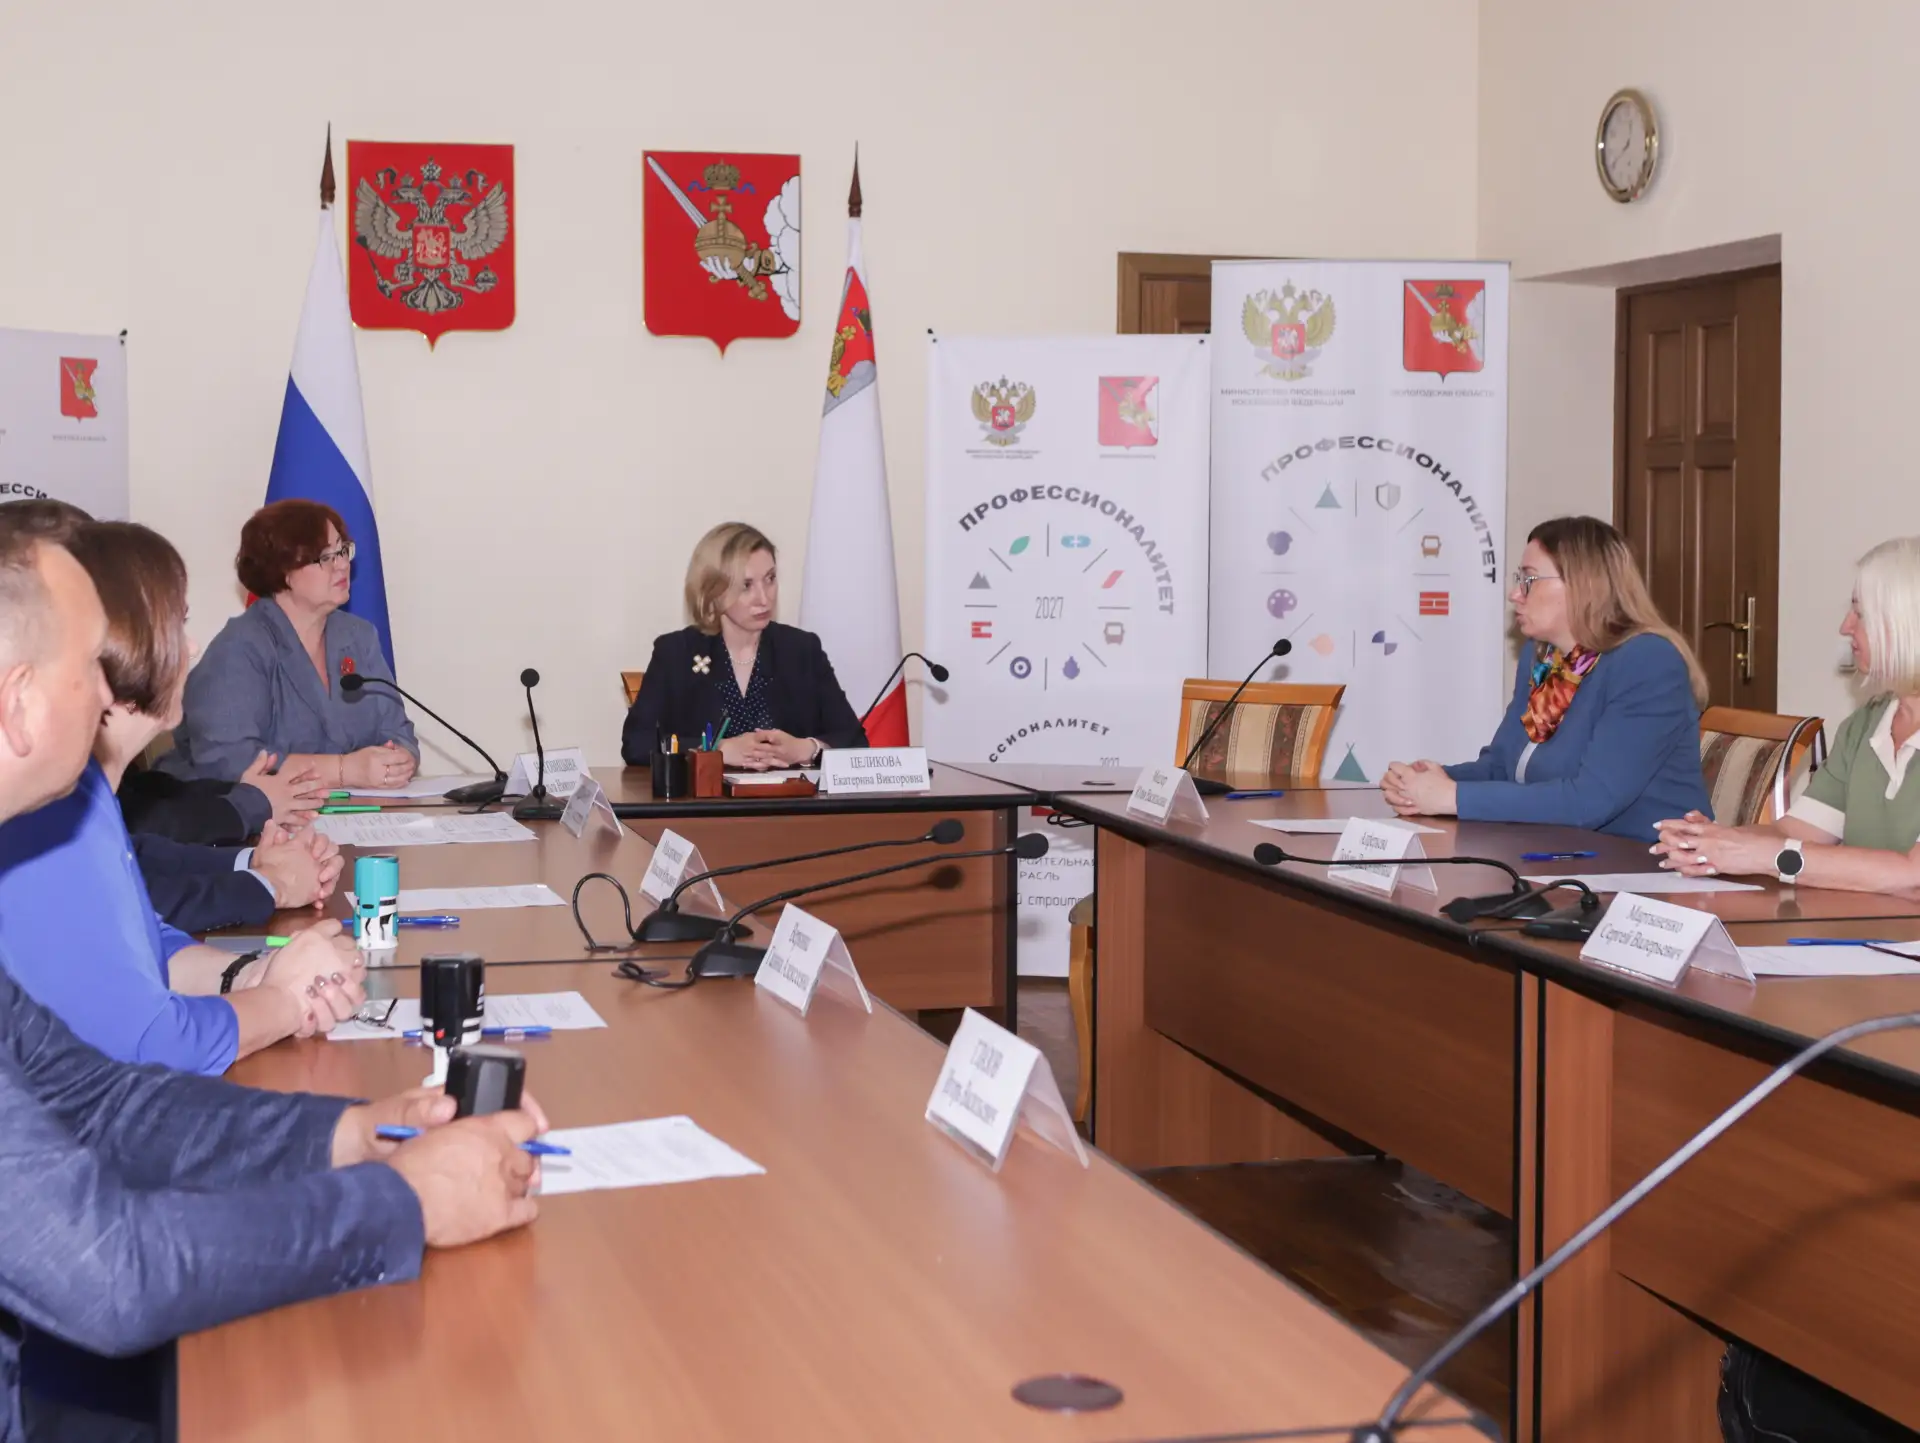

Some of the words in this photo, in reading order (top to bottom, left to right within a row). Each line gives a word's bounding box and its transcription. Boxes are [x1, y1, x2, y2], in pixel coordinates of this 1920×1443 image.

[1260, 436, 1496, 583] ПРОФЕССИОНАЛИТЕТ
[958, 484, 1174, 615] ПРОФЕССИОНАЛИТЕТ
[1035, 596, 1064, 619] 2027
[850, 755, 902, 768] ЦЕЛИКОВА
[832, 774, 874, 788] Екатерина
[876, 773, 924, 787] Викторовна
